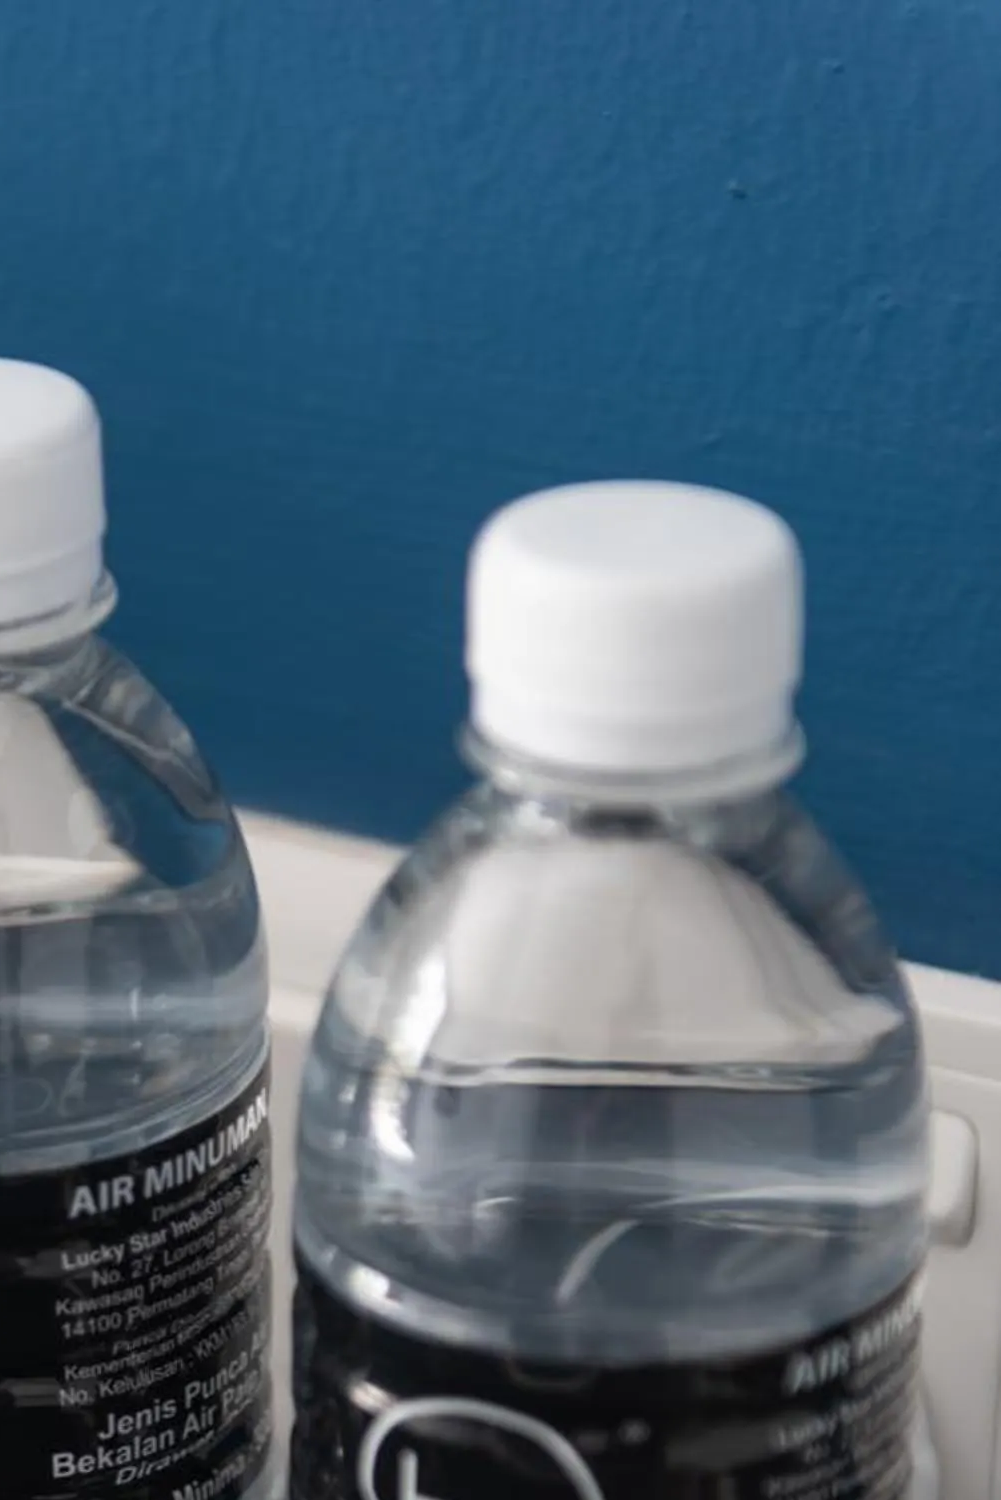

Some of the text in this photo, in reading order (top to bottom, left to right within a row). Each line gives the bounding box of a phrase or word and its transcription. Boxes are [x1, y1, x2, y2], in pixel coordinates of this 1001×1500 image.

[67, 1174, 136, 1220] AIR
[143, 1087, 267, 1199] MINUMAN
[60, 1243, 126, 1272] Lucky
[129, 1226, 170, 1254] Star
[58, 1386, 94, 1406] No.
[97, 1398, 178, 1440] Jenis
[52, 1428, 176, 1479] Bekalan
[182, 1404, 217, 1441] Air
